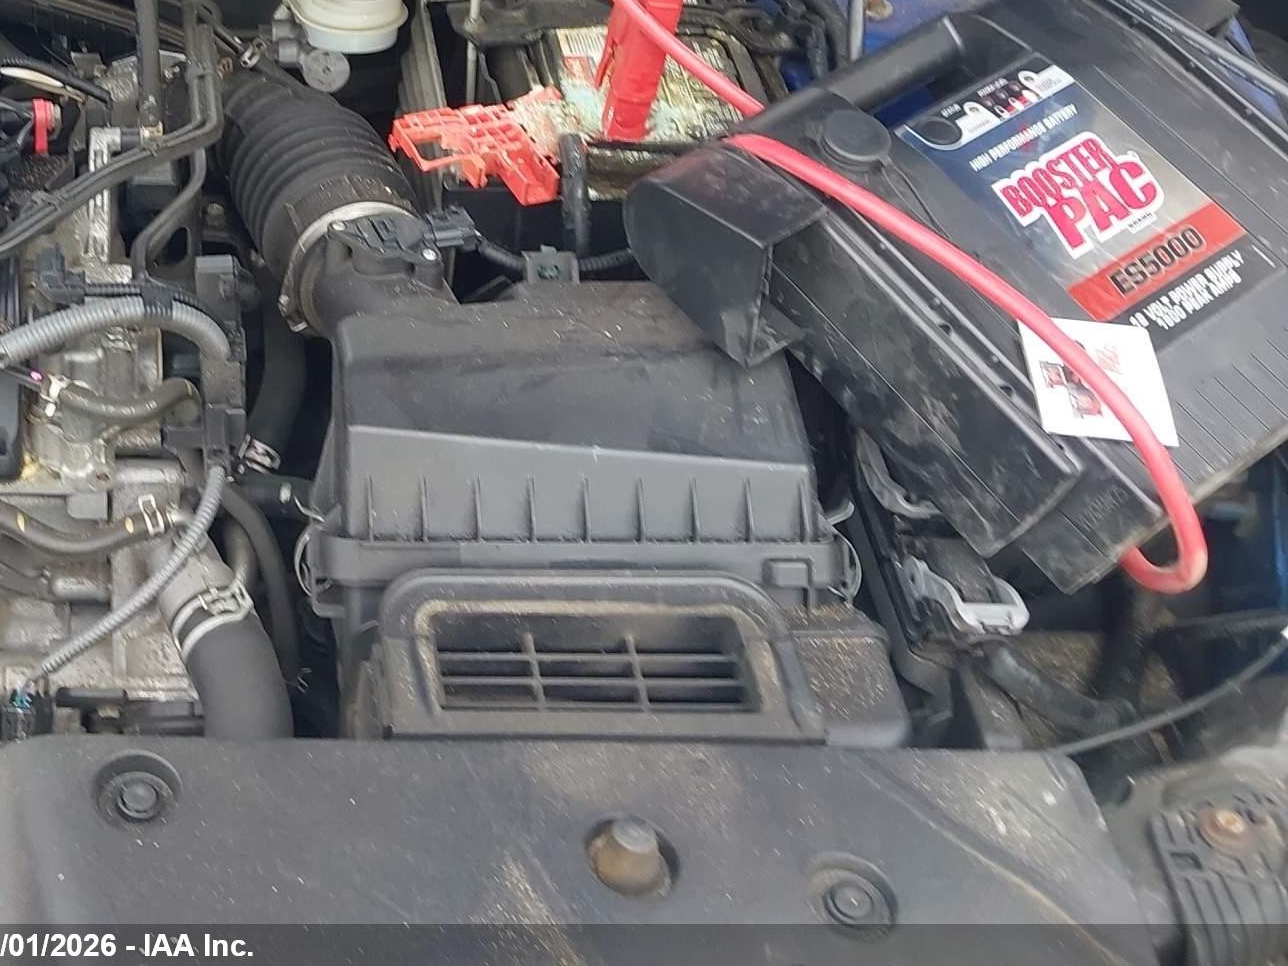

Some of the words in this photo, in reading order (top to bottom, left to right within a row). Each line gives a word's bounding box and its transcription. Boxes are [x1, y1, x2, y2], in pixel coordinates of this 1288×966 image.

[969, 153, 993, 172] HIGH
[1042, 102, 1078, 135] BATTERY
[1000, 138, 1116, 217] BOOSTER
[1043, 160, 1157, 248] PAC
[1110, 227, 1204, 294] ES5000
